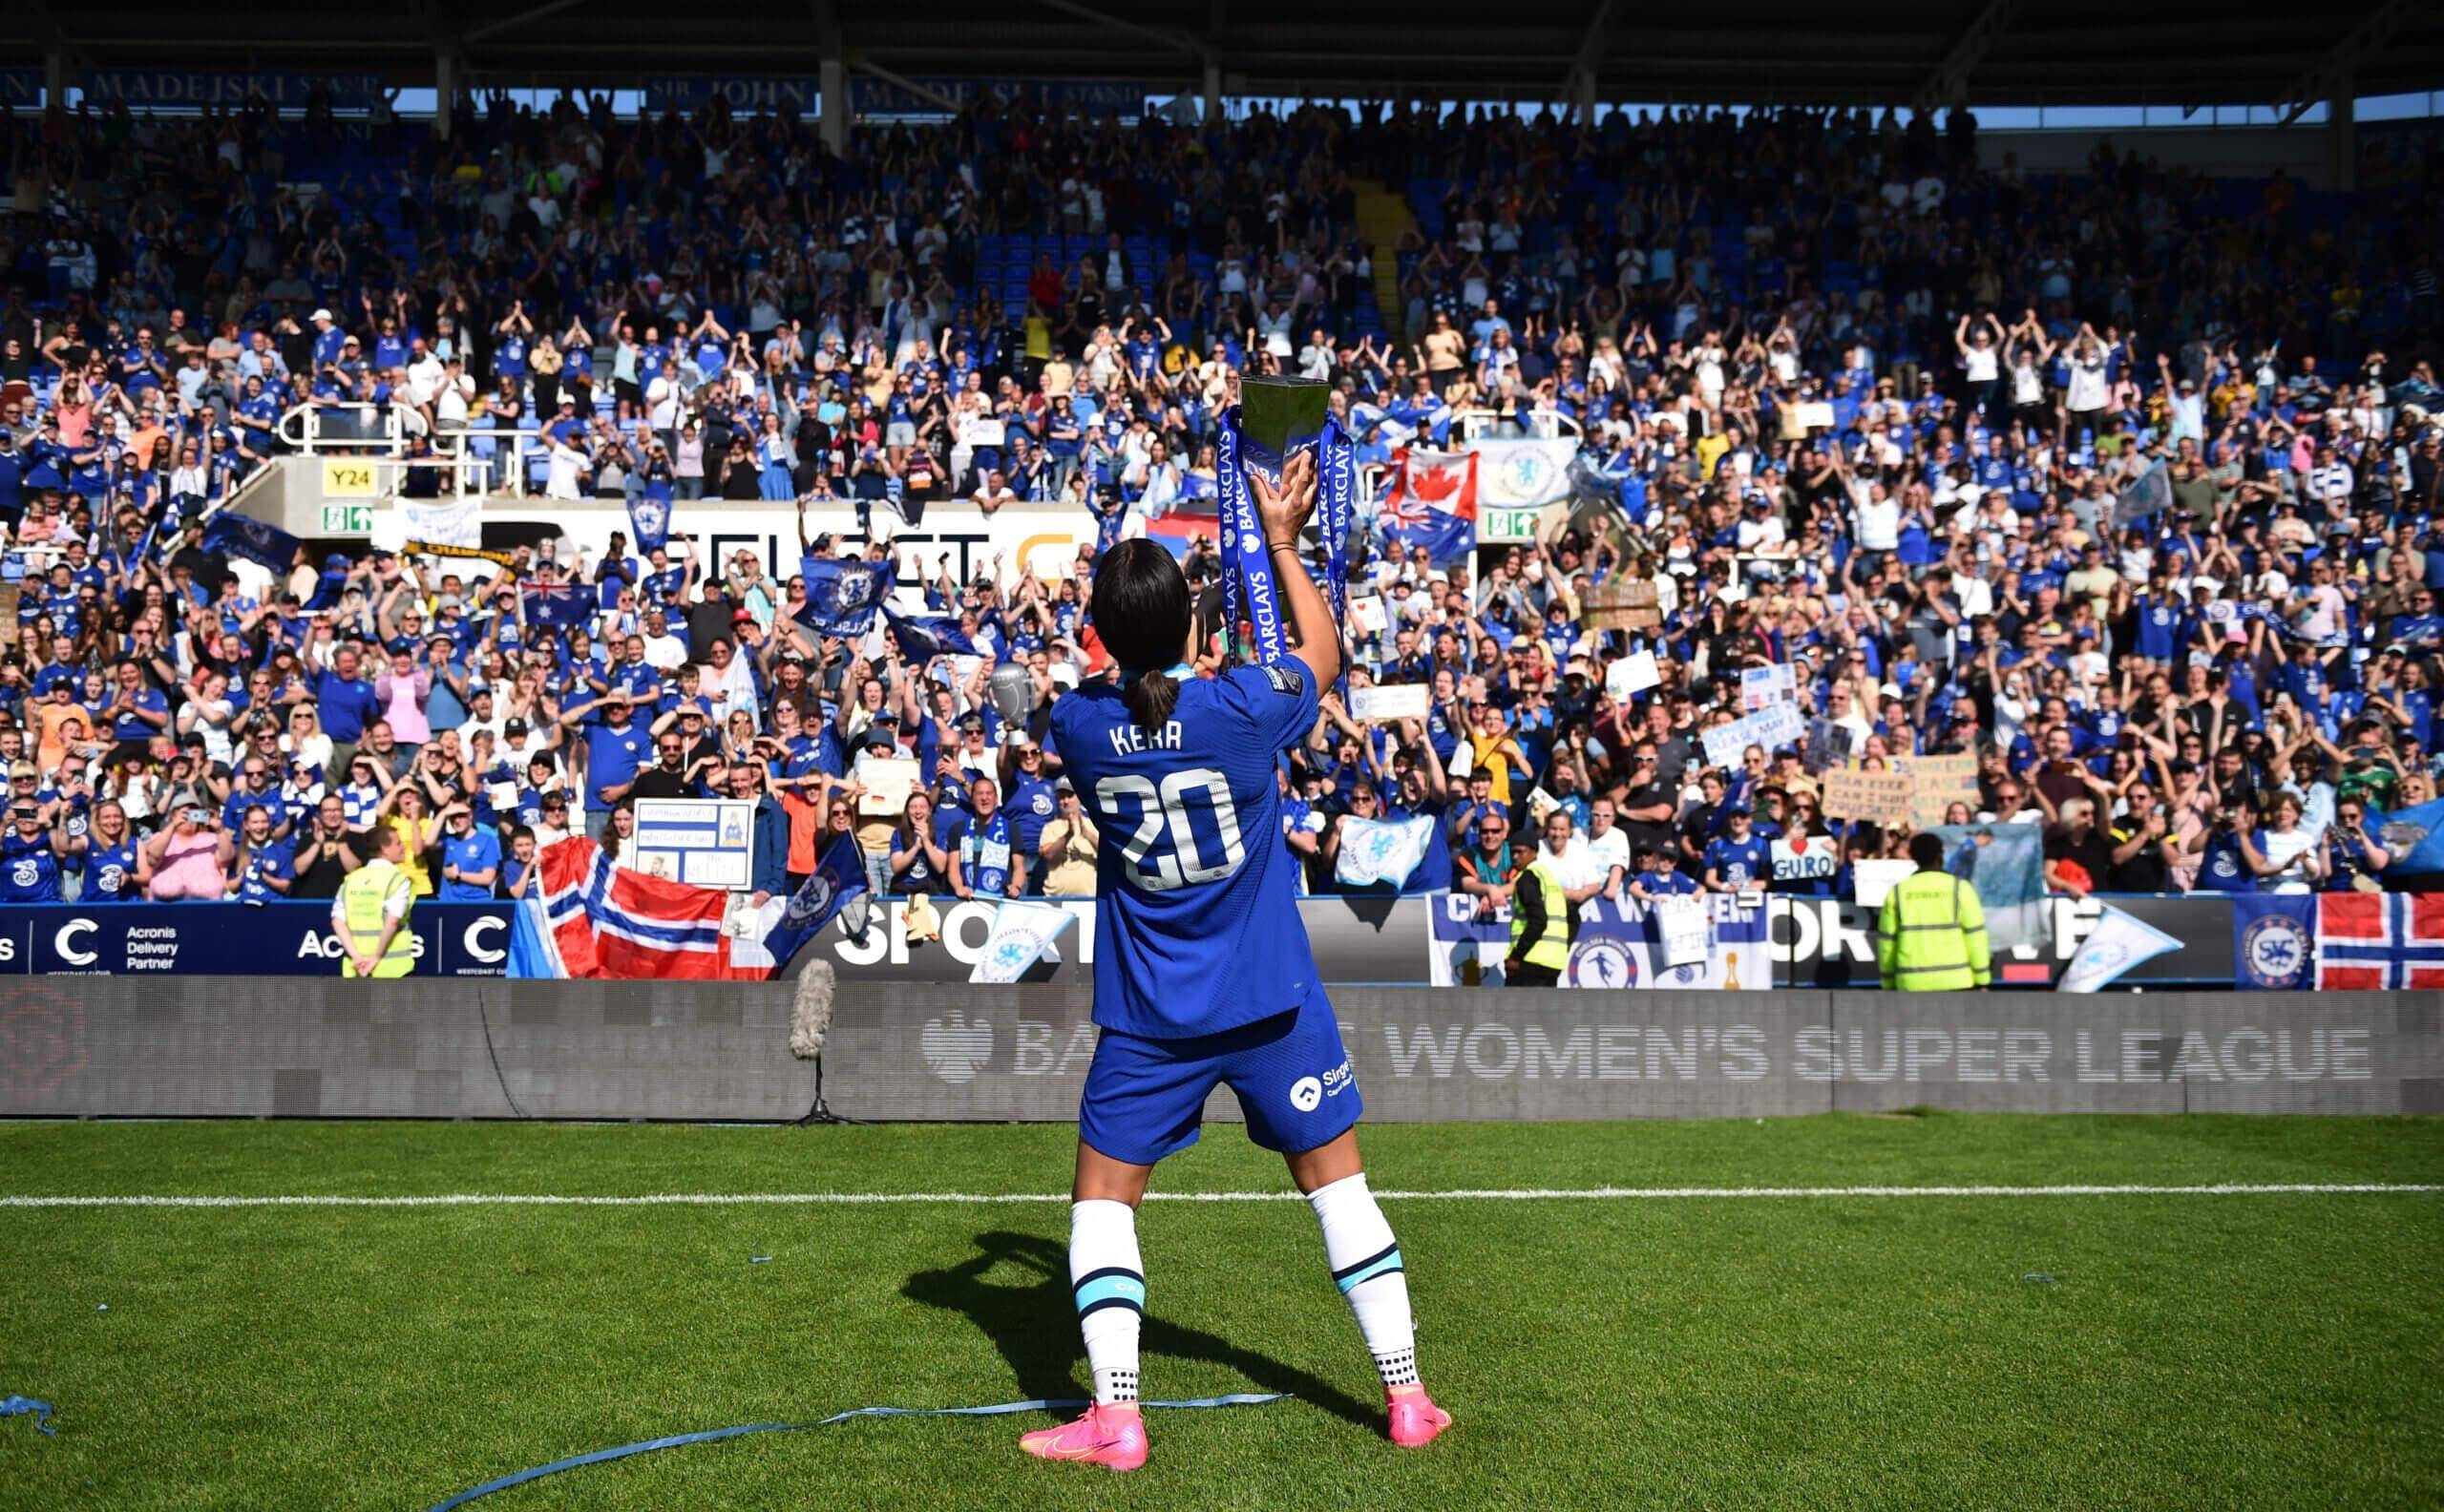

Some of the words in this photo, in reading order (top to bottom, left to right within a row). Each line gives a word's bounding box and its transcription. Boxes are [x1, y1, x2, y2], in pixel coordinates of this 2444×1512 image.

[96, 74, 285, 101] MADEJSKI
[652, 79, 690, 97] SIR
[711, 79, 810, 107] JOHN
[333, 470, 369, 486] Y24
[1220, 430, 1234, 524] BARCLAYS
[1334, 438, 1349, 527] BARCLAYS
[1250, 571, 1281, 663] BARCLAYS
[1109, 721, 1182, 756] KERR
[1095, 767, 1246, 892] 20
[1773, 855, 1831, 877] GURO
[127, 927, 177, 939] Acronis
[127, 942, 179, 957] Delivery
[127, 958, 175, 970] Partner
[1384, 1021, 1771, 1082] WOMEN'S
[1793, 1025, 2053, 1084] SUPER
[2075, 1024, 2373, 1083] LEAGUE
